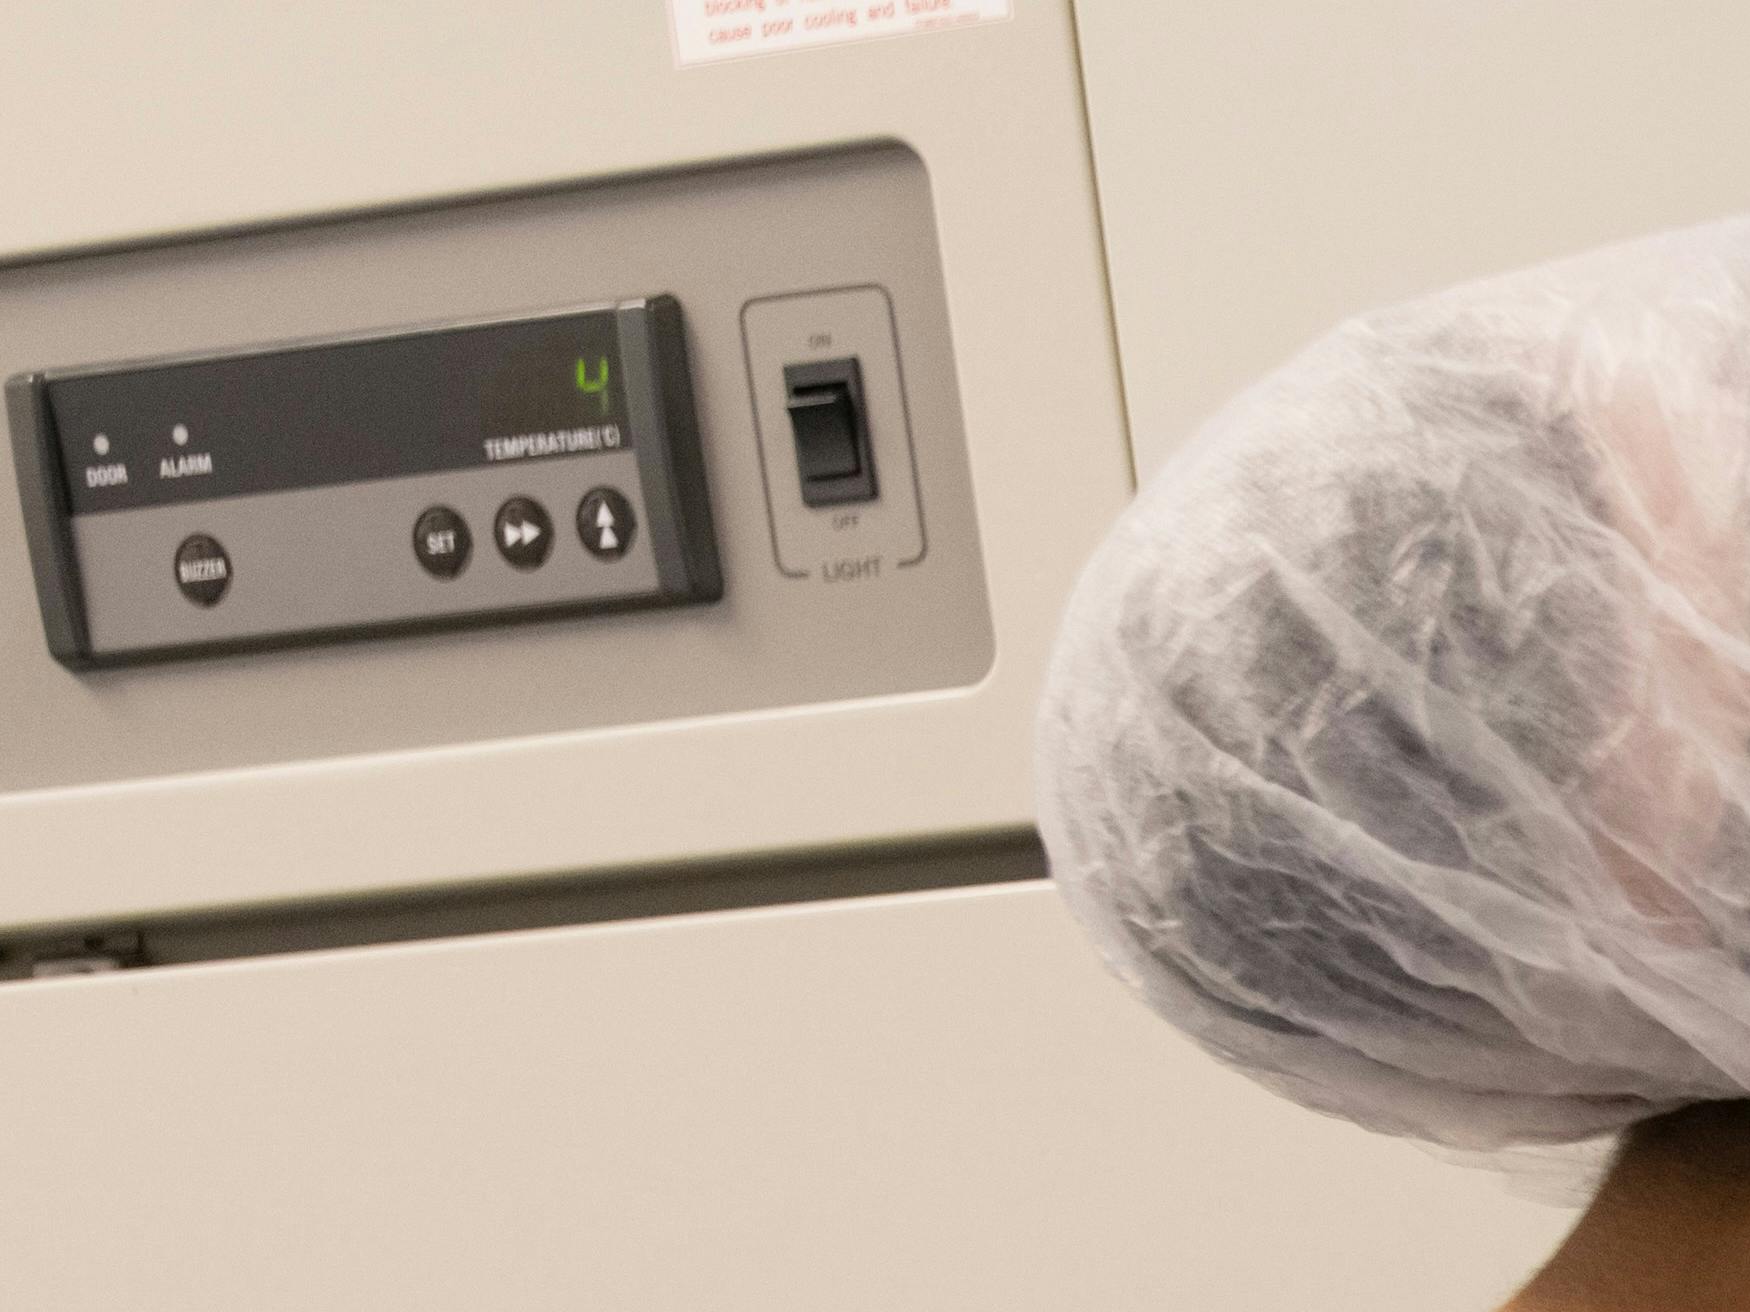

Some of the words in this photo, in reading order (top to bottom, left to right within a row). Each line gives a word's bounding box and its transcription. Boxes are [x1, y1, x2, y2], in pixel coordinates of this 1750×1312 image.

[85, 463, 128, 488] DOOR
[159, 452, 213, 480] ALARM
[426, 529, 455, 555] SET
